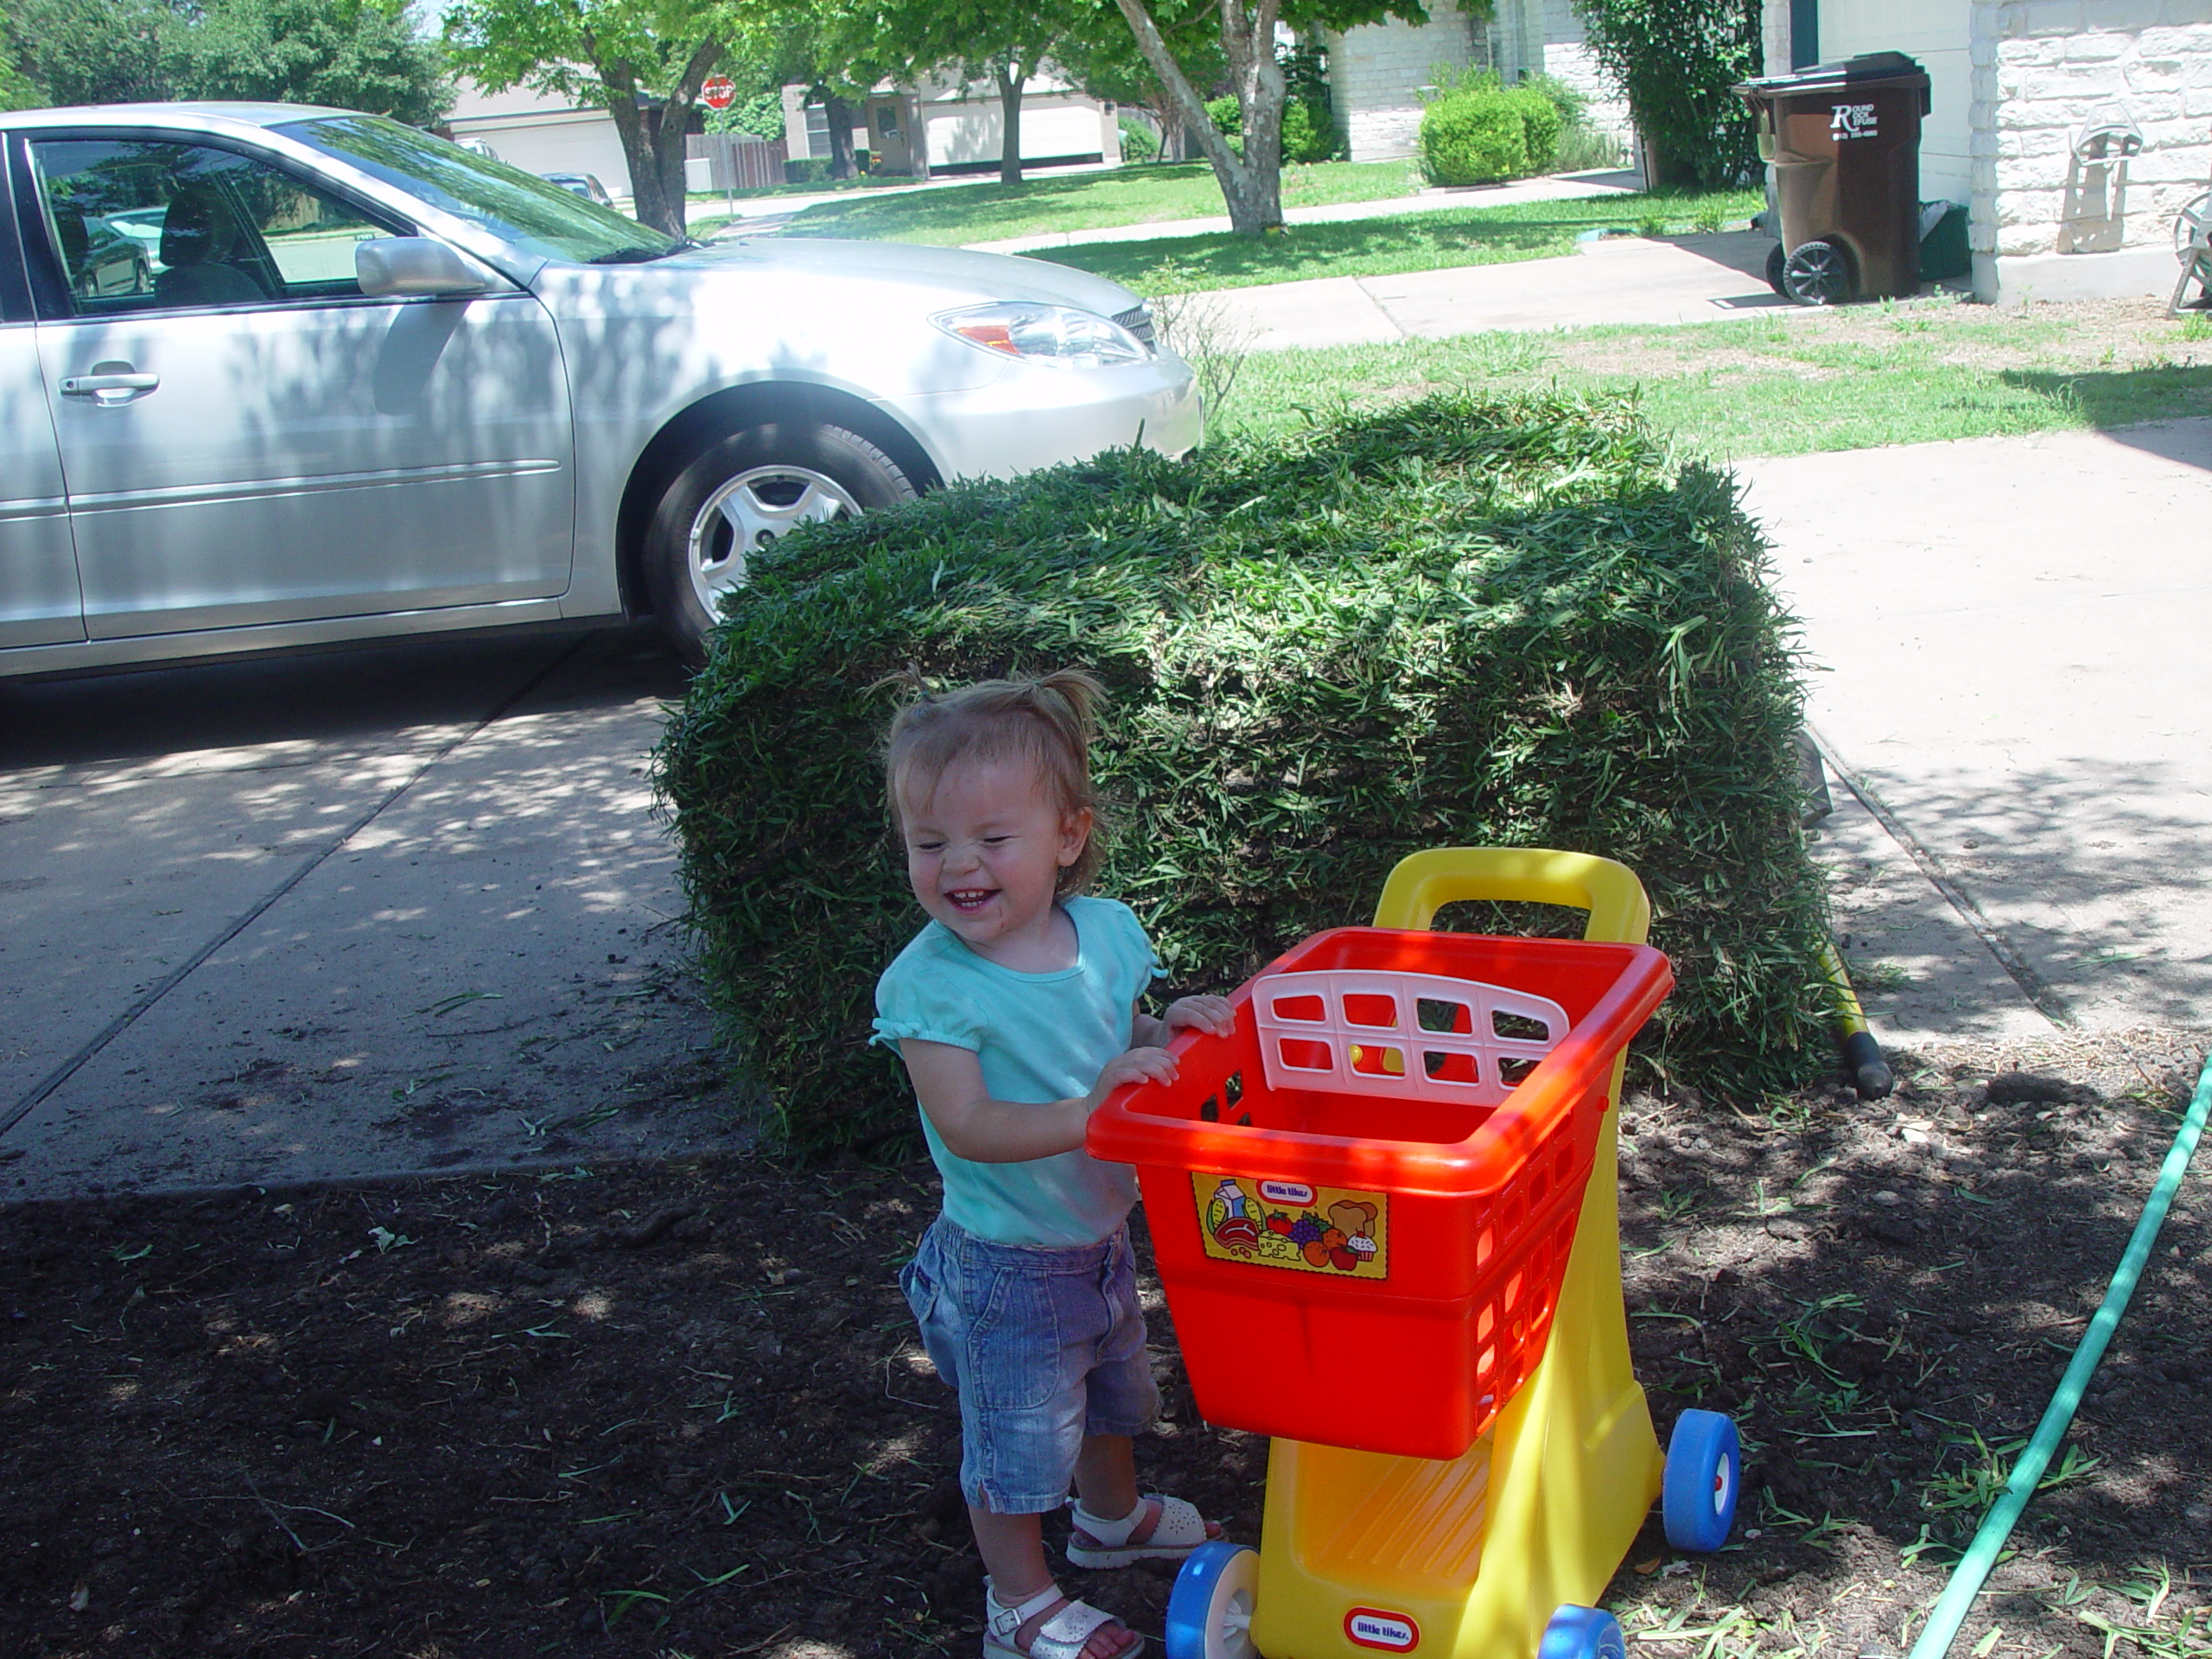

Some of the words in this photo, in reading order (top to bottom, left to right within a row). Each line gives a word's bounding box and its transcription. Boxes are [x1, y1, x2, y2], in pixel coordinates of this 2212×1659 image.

[704, 85, 734, 99] STOP
[1267, 1184, 1287, 1195] little
[1287, 1187, 1308, 1198] tikes
[1357, 1621, 1381, 1635] little
